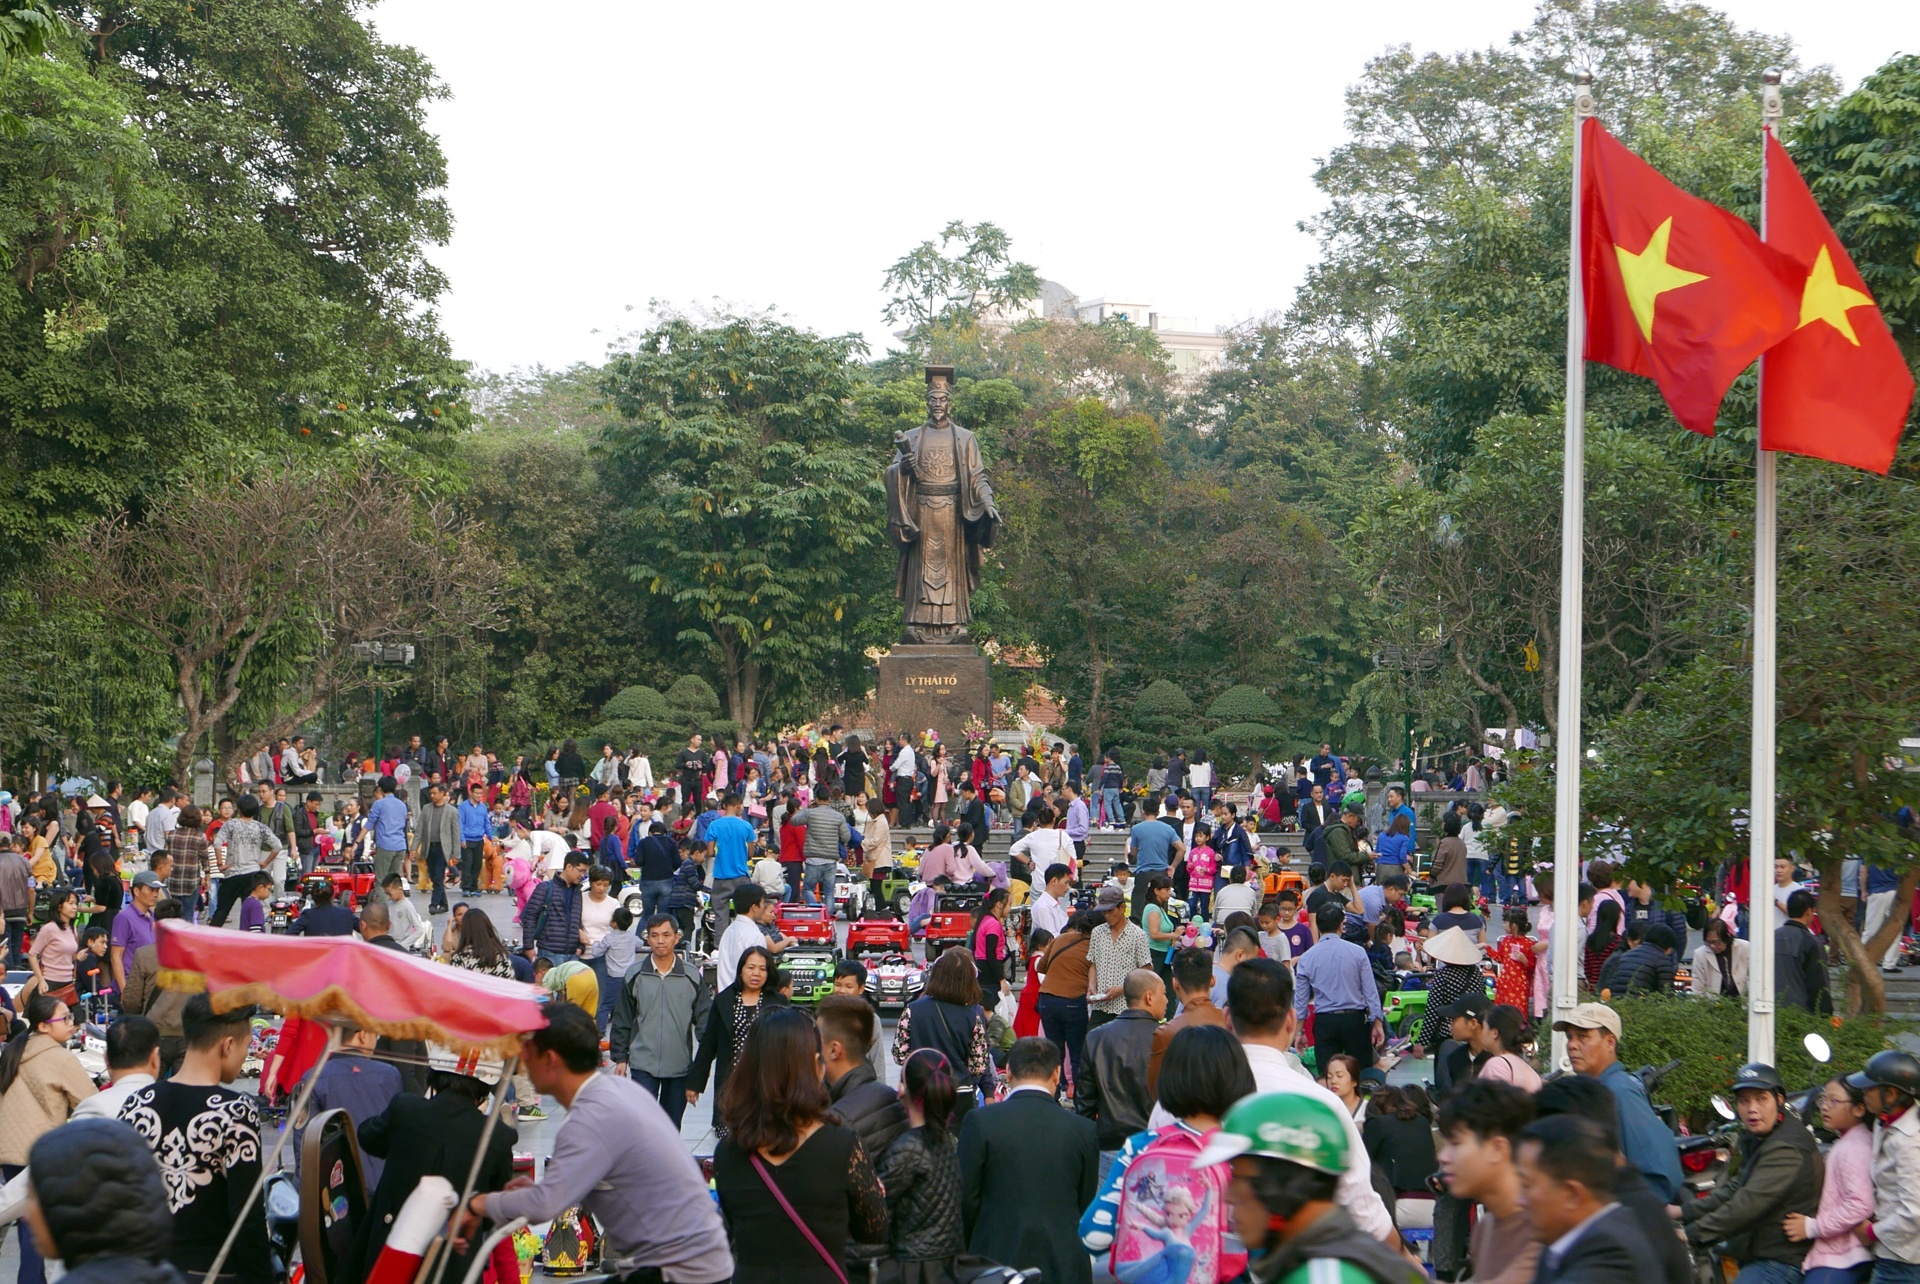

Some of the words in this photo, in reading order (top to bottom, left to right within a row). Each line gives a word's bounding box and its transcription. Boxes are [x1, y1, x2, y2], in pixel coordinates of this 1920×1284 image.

[905, 675, 916, 686] LÝ
[918, 675, 942, 686] THÁI
[943, 673, 957, 686] TỔ
[1257, 1122, 1321, 1149] Grab
